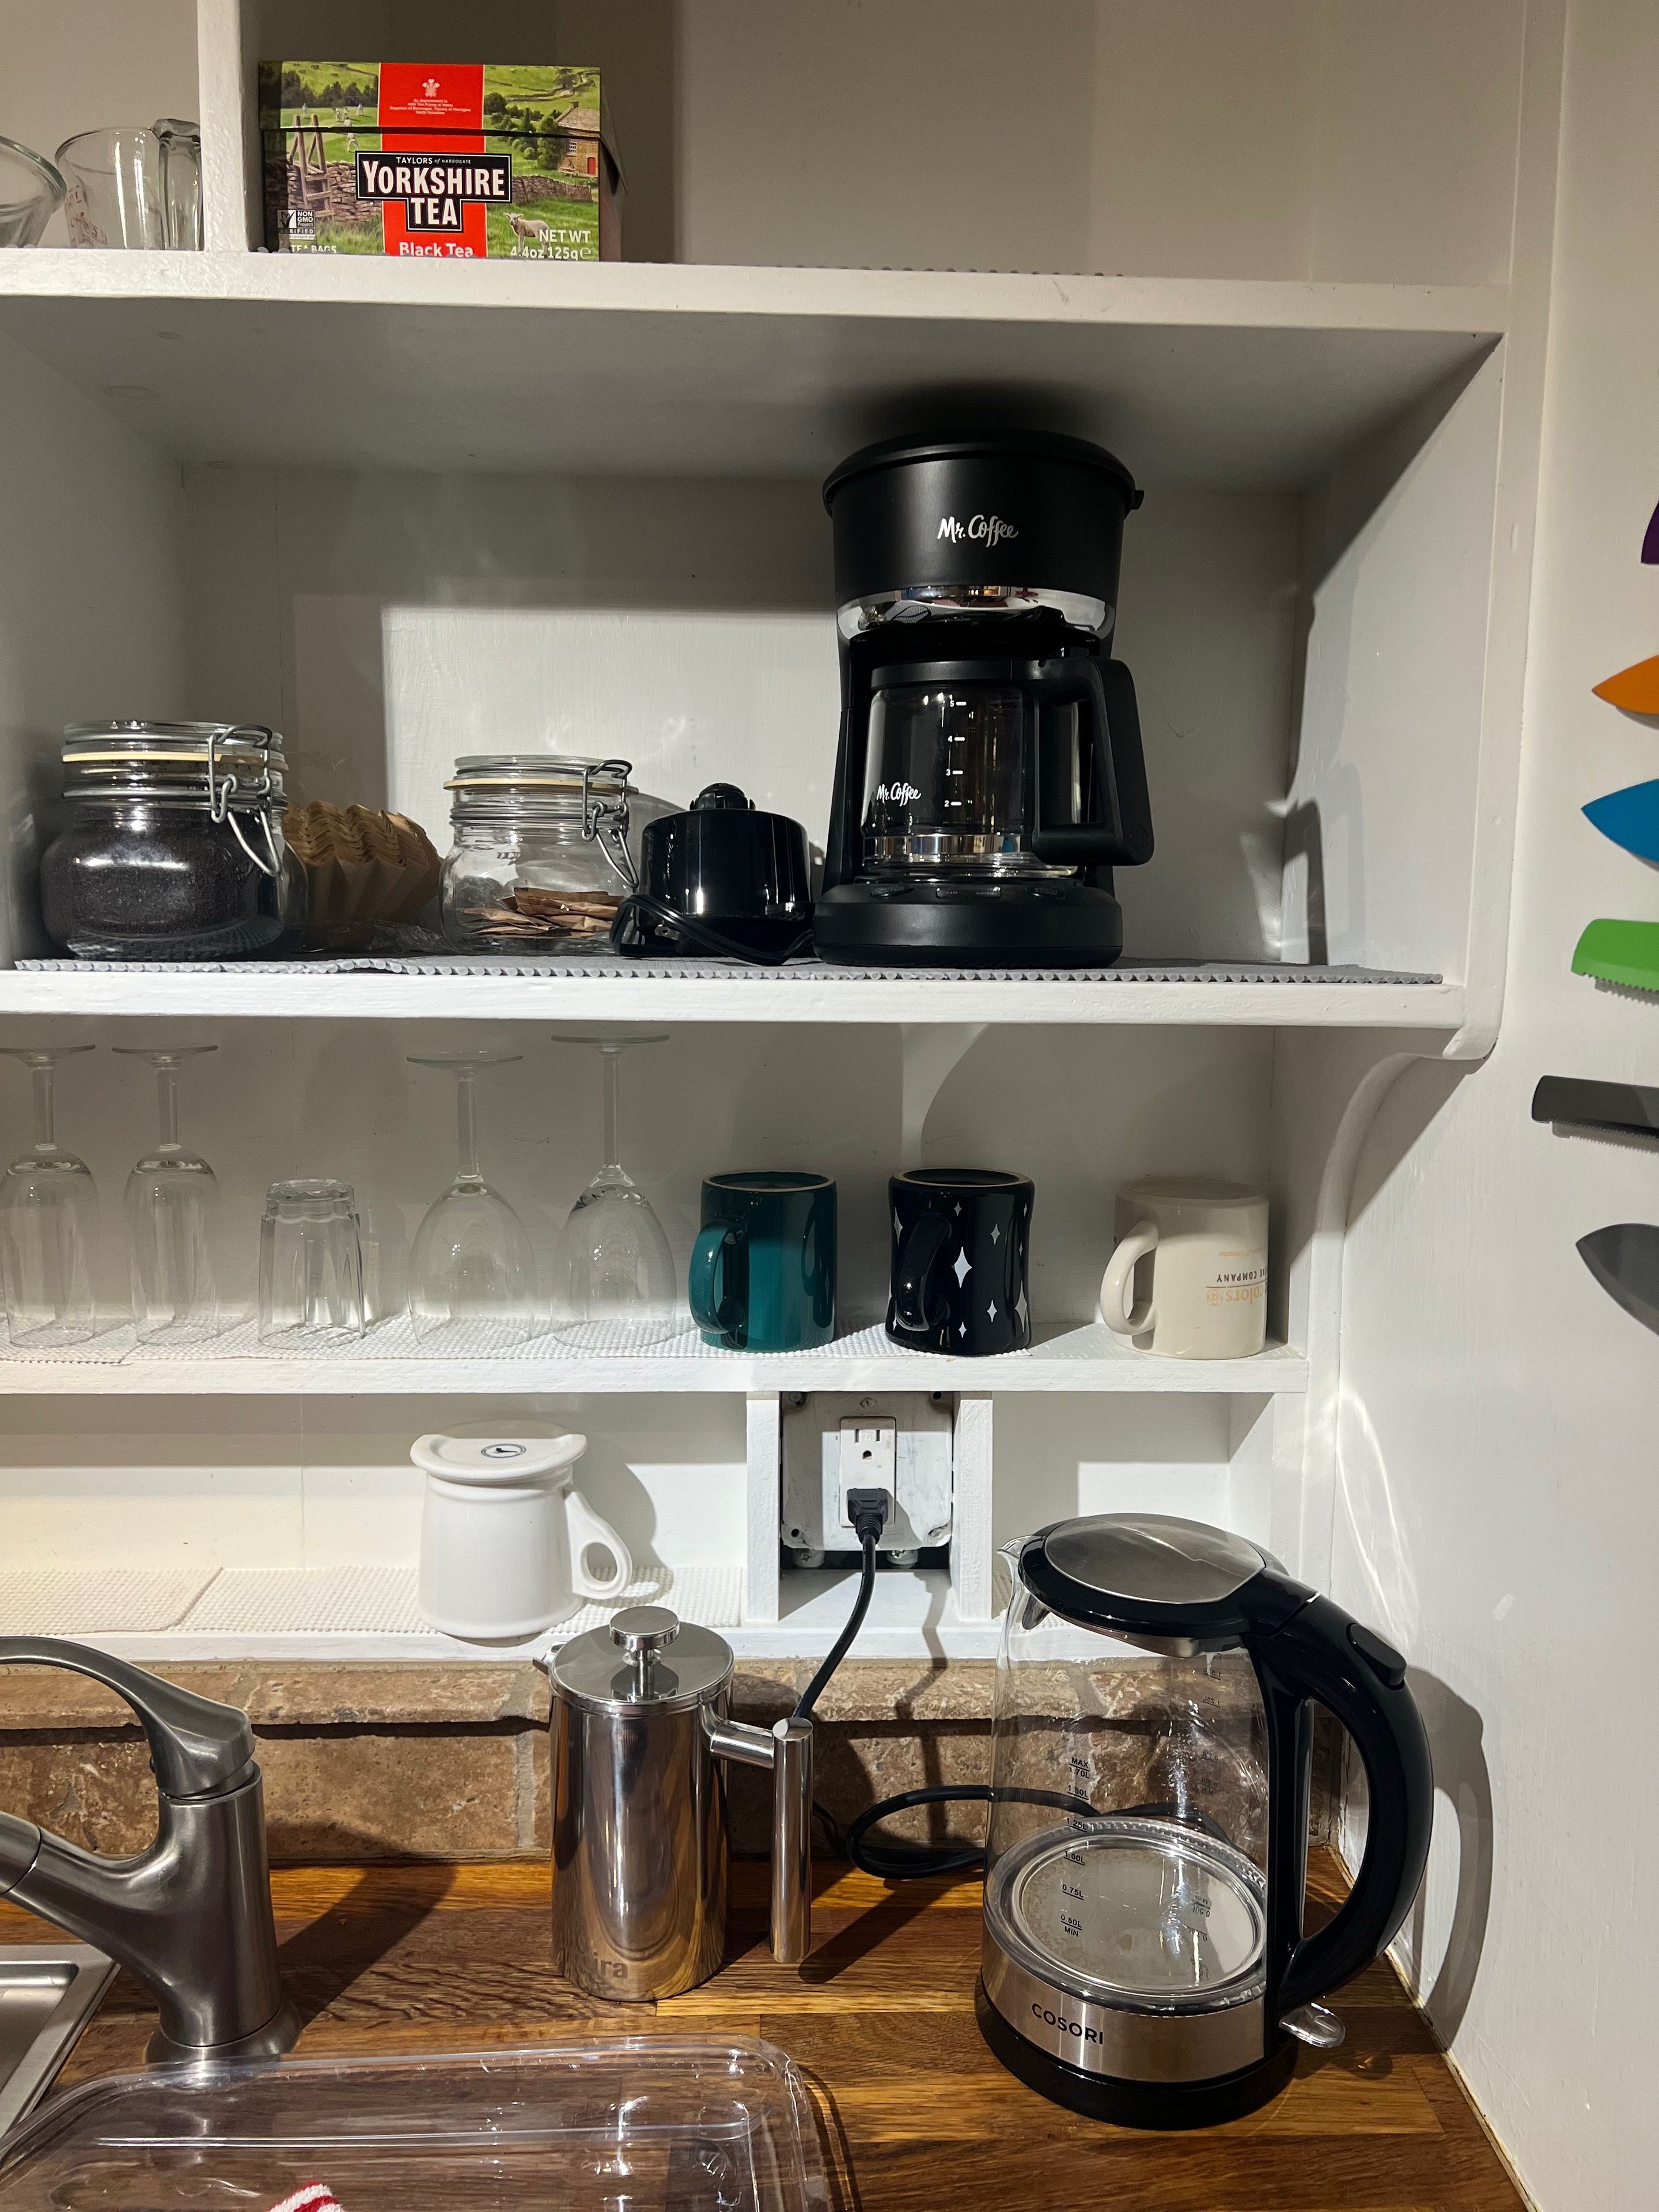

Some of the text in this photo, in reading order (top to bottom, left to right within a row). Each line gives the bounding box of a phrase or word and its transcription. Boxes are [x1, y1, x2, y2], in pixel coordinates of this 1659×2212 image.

[363, 161, 505, 196] YORKSHIRE
[411, 198, 458, 225] TEA
[539, 229, 591, 243] NET WT
[399, 241, 474, 257] Black Tea
[510, 246, 544, 259] 4.4oz
[937, 514, 1018, 547] Mr. Coffee
[876, 782, 922, 806] Mr. Coffee
[1217, 1271, 1257, 1282] COMPANY
[1071, 1756, 1088, 1768] MAX
[1069, 1767, 1089, 1779] 1.70L
[1068, 1785, 1088, 1797] 1.50L
[1067, 1817, 1087, 1830] 1.25L
[1065, 1851, 1085, 1863] 1.00L
[1062, 1884, 1084, 1897] 0.75L
[1060, 1914, 1082, 1927] 0.50L
[1065, 1926, 1078, 1937] MIN
[586, 1951, 628, 1979] ira
[1032, 2003, 1103, 2044] COSORI
